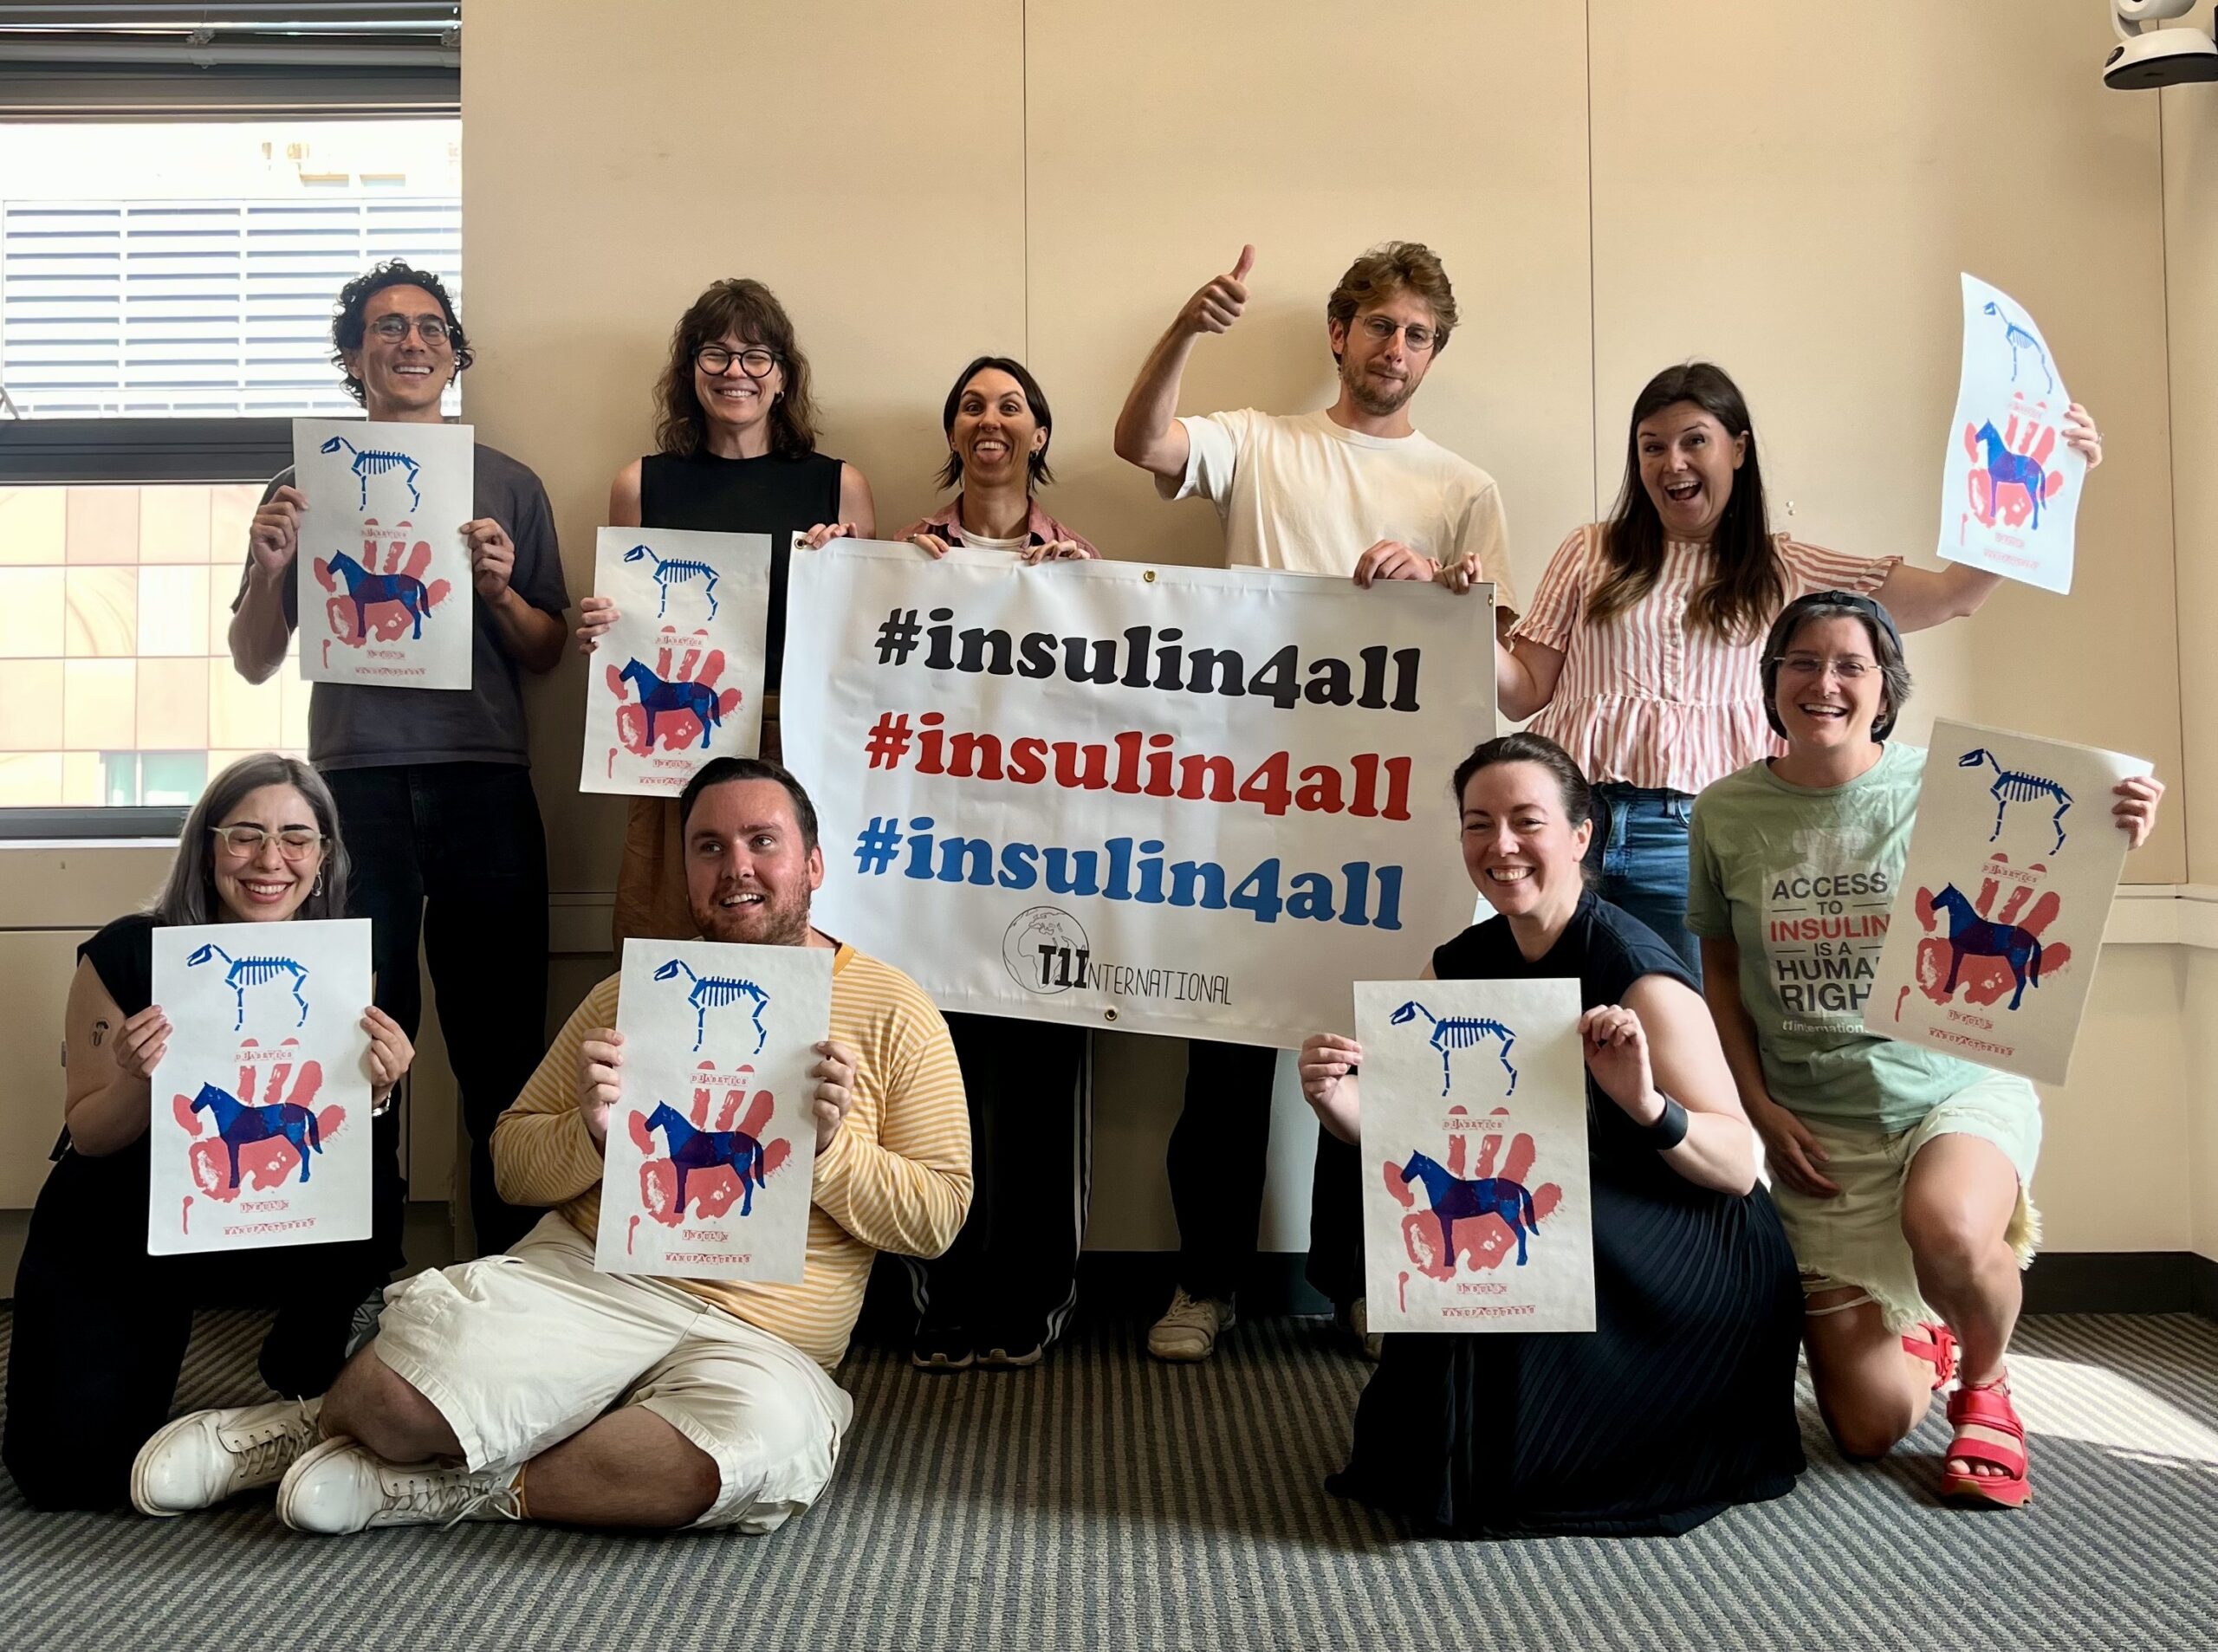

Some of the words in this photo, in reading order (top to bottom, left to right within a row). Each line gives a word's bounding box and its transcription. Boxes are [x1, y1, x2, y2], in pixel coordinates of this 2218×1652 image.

[874, 606, 1421, 712] #insulin4all
[865, 712, 1411, 821] #insulin4all
[853, 816, 1404, 931] #insulin4all
[1772, 872, 1888, 901] ACCESS
[1817, 900, 1843, 915] TO
[1770, 914, 1890, 942] INSULIN
[1815, 943, 1832, 956] IS
[1839, 942, 1852, 956] A
[1776, 956, 1880, 981] HUMA
[1780, 982, 1871, 1012] RIGH
[1782, 1020, 1865, 1033] t1internation
